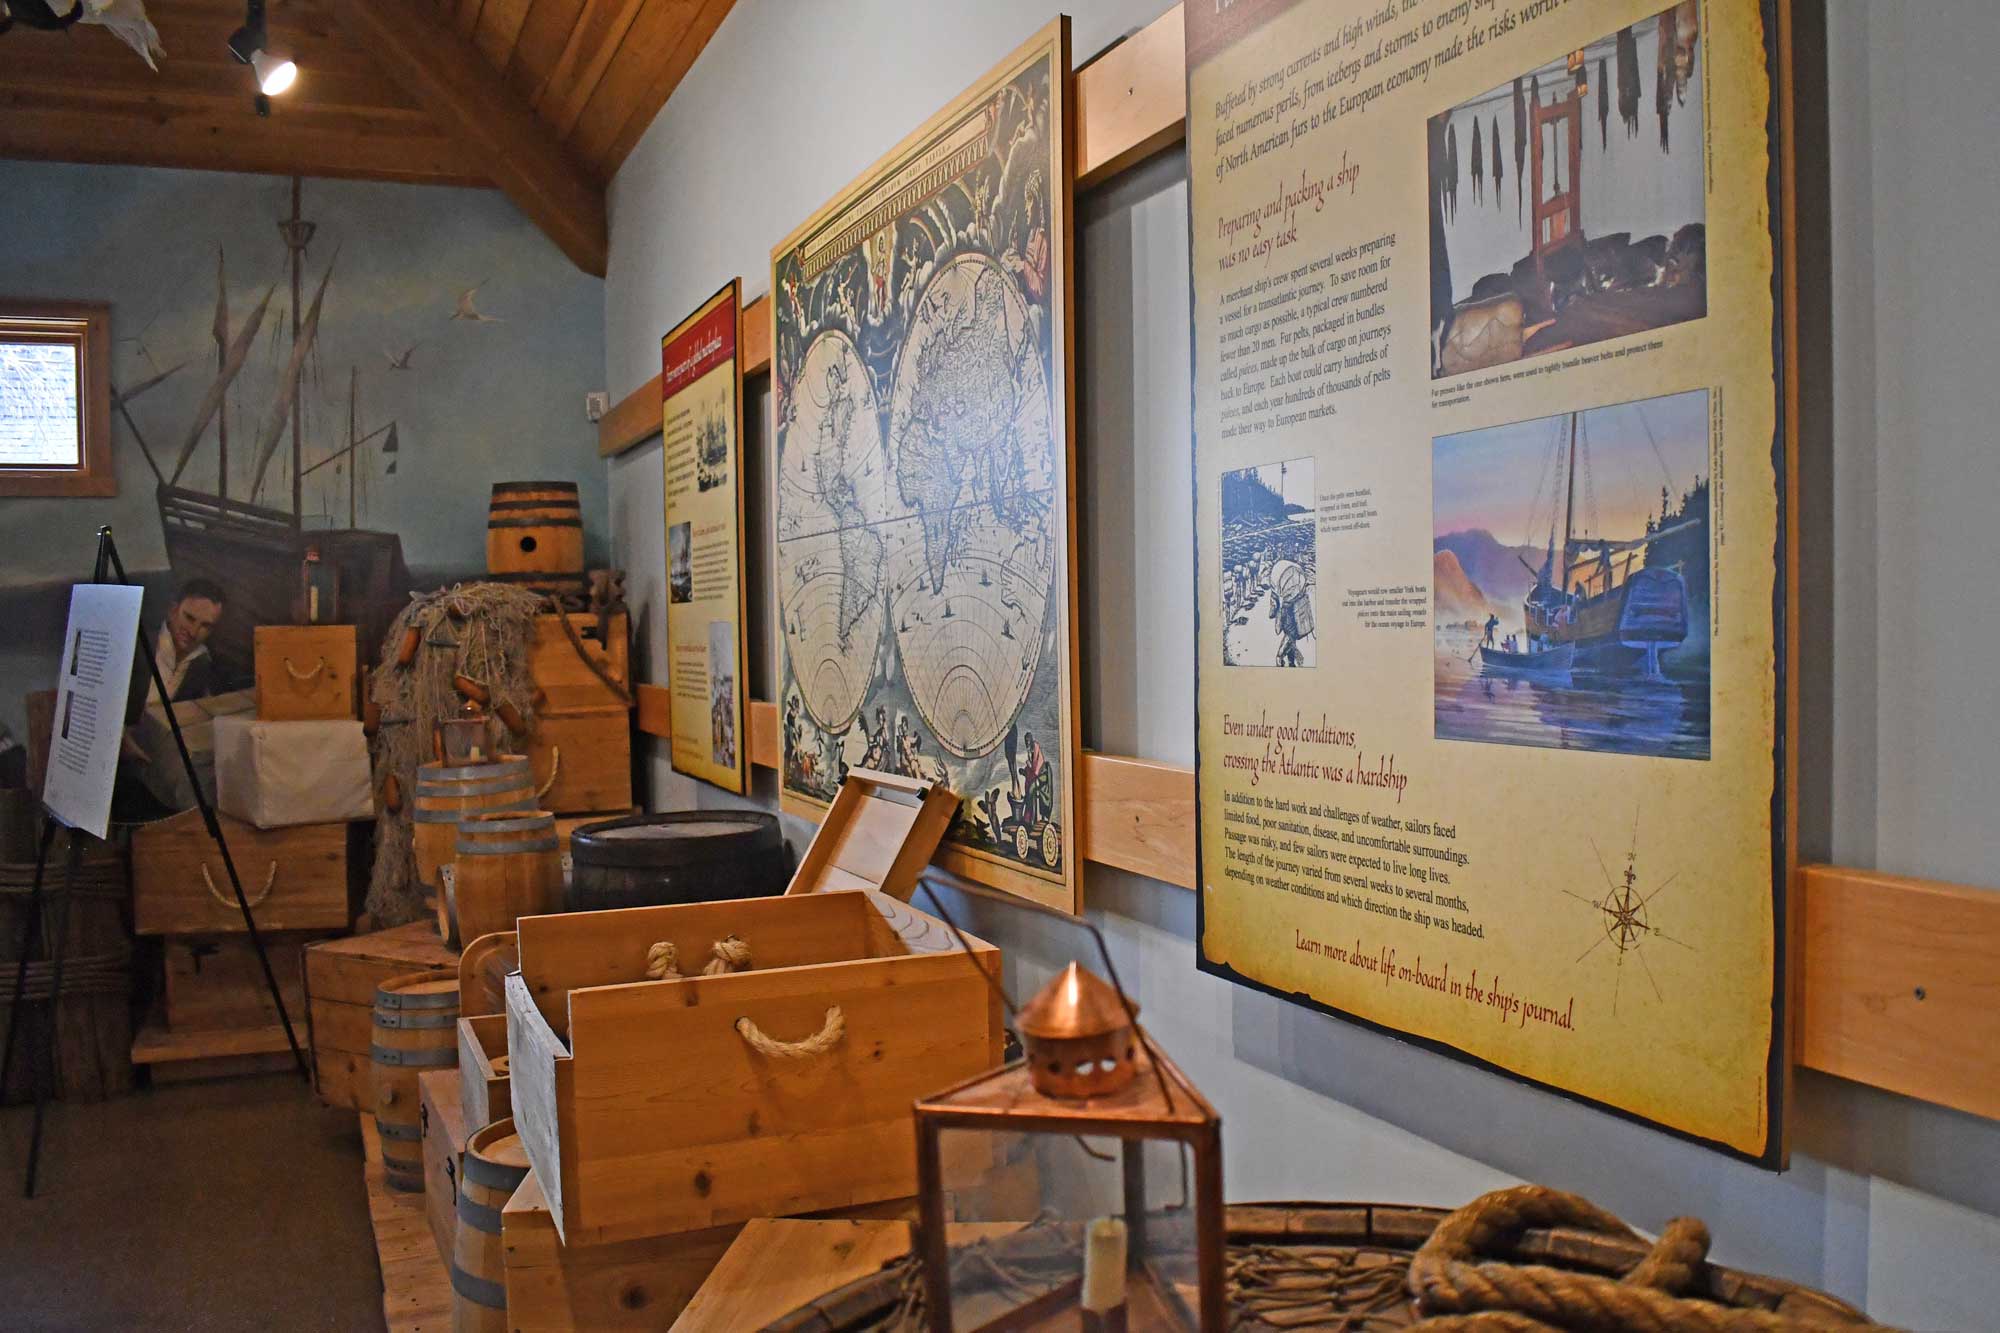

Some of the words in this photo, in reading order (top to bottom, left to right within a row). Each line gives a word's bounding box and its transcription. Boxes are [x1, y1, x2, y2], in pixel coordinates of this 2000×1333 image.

[1214, 123, 1234, 157] faced
[1235, 106, 1274, 136] numerous
[1275, 86, 1301, 124] perils,
[1301, 79, 1325, 110] from
[1326, 58, 1361, 88] icebergs
[1363, 39, 1383, 68] and
[1384, 27, 1419, 58] storms
[1422, 19, 1433, 37] to
[1436, 1, 1471, 30] enemy
[1215, 83, 1246, 122] Buffeted
[1247, 79, 1257, 106] by
[1258, 67, 1284, 94] strong
[1286, 47, 1321, 78] currents
[1323, 28, 1341, 57] and
[1342, 16, 1363, 50] high
[1365, 0, 1399, 32] winds,
[1215, 155, 1225, 184] of
[1225, 143, 1248, 173] North
[1250, 130, 1290, 161] American
[1289, 118, 1308, 149] furs
[1310, 113, 1320, 130] to
[1322, 101, 1337, 124] the
[1339, 81, 1384, 116] European
[1386, 56, 1431, 92] economy
[1434, 34, 1463, 68] made
[1466, 25, 1485, 52] the
[1488, 8, 1516, 41] risks
[1218, 207, 1262, 246] Preparing
[1263, 180, 1283, 219] and
[1284, 168, 1325, 224] packing
[1326, 175, 1334, 192] a
[1336, 149, 1359, 195] ship
[1218, 252, 1236, 271] was
[1238, 247, 1250, 263] no
[1252, 237, 1274, 268] easy
[1276, 209, 1297, 248] task
[1219, 294, 1225, 305] A
[1226, 284, 1253, 303] merchant
[1254, 276, 1272, 294] ship's
[1272, 272, 1289, 287] crew
[1290, 263, 1308, 283] spent
[1309, 252, 1334, 273] several
[1334, 245, 1357, 263] weeks
[1359, 233, 1396, 259] preparing
[1224, 305, 1242, 323] vessel
[1243, 303, 1252, 317] for
[1258, 290, 1297, 312] transatlantic
[1297, 281, 1326, 302] journey.
[1329, 273, 1339, 287] To
[1340, 269, 1357, 284] save
[1358, 262, 1378, 278] room
[1380, 255, 1391, 270] for
[1227, 325, 1244, 342] much
[1244, 322, 1262, 336] cargo
[1271, 308, 1299, 331] possible,
[1300, 308, 1305, 318] a
[1306, 295, 1330, 319] typical
[1331, 294, 1349, 308] crew
[1350, 276, 1388, 302] numbered
[1237, 344, 1250, 357] than
[1251, 339, 1260, 353] 20
[1260, 338, 1277, 350] men.
[1280, 331, 1292, 345] Fur
[1293, 325, 1311, 344] pelts,
[1312, 312, 1345, 338] packaged
[1346, 313, 1355, 325] in
[1355, 303, 1385, 322] bundles
[1223, 713, 1243, 736] Even
[1246, 708, 1274, 739] under
[1276, 711, 1300, 755] good
[1301, 712, 1356, 749] conditions,
[1223, 754, 1259, 786] crossing
[1261, 742, 1277, 774] the
[1278, 745, 1319, 779] Atlantic
[1321, 766, 1343, 782] was
[1345, 769, 1353, 784] a
[1356, 751, 1407, 804] hardship
[1223, 789, 1230, 802] In
[1231, 791, 1255, 806] addition
[1256, 796, 1263, 807] to
[1263, 796, 1274, 809] the
[1274, 797, 1290, 812] hard
[1291, 801, 1308, 815] work
[1308, 804, 1322, 817] and
[1323, 805, 1360, 825] challenges
[1361, 811, 1371, 825] of
[1370, 814, 1403, 832] weather,
[1404, 819, 1431, 835] sailors
[1433, 822, 1456, 839] faced
[1223, 808, 1245, 823] limited
[1245, 812, 1261, 827] food,
[1262, 818, 1277, 830] poor
[1277, 821, 1311, 837] sanitation,
[1312, 823, 1340, 842] disease,
[1340, 830, 1355, 844] and
[1356, 835, 1411, 854] uncomfortable
[1412, 845, 1470, 867] surroundings.
[1224, 826, 1247, 845] Passage
[1247, 835, 1260, 846] was
[1260, 835, 1278, 852] risky,
[1279, 839, 1291, 852] and
[1292, 840, 1305, 854] few
[1306, 844, 1328, 859] sailors
[1329, 851, 1347, 863] were
[1348, 855, 1381, 870] expected
[1382, 860, 1391, 872] to
[1392, 859, 1407, 876] live
[1409, 863, 1427, 883] long
[1429, 866, 1450, 884] lives.
[1224, 845, 1236, 860] The
[1236, 848, 1256, 866] length
[1256, 853, 1264, 866] of
[1264, 855, 1274, 868] the
[1275, 860, 1300, 876] journey
[1301, 865, 1323, 879] varied
[1324, 867, 1341, 883] from
[1342, 874, 1368, 889] several
[1369, 879, 1393, 895] weeks
[1395, 884, 1403, 897] to
[1405, 888, 1433, 904] several
[1435, 895, 1469, 913] months,
[1224, 864, 1255, 886] depending
[1255, 875, 1264, 885] on
[1265, 876, 1290, 891] weather
[1290, 883, 1325, 900] conditions
[1326, 890, 1339, 903] and
[1340, 892, 1363, 909] which
[1364, 897, 1398, 918] direction
[1399, 906, 1412, 921] the
[1413, 909, 1431, 929] ship
[1432, 917, 1449, 930] was
[1451, 917, 1485, 939] headed.
[1295, 928, 1321, 955] Learn
[1323, 944, 1347, 963] more
[1349, 938, 1378, 972] about
[1380, 945, 1396, 987] life
[1398, 955, 1448, 992] on-board
[1450, 980, 1461, 997] in
[1465, 969, 1483, 1003] the
[1486, 975, 1519, 1023] ship's
[1520, 997, 1575, 1031] journal.
